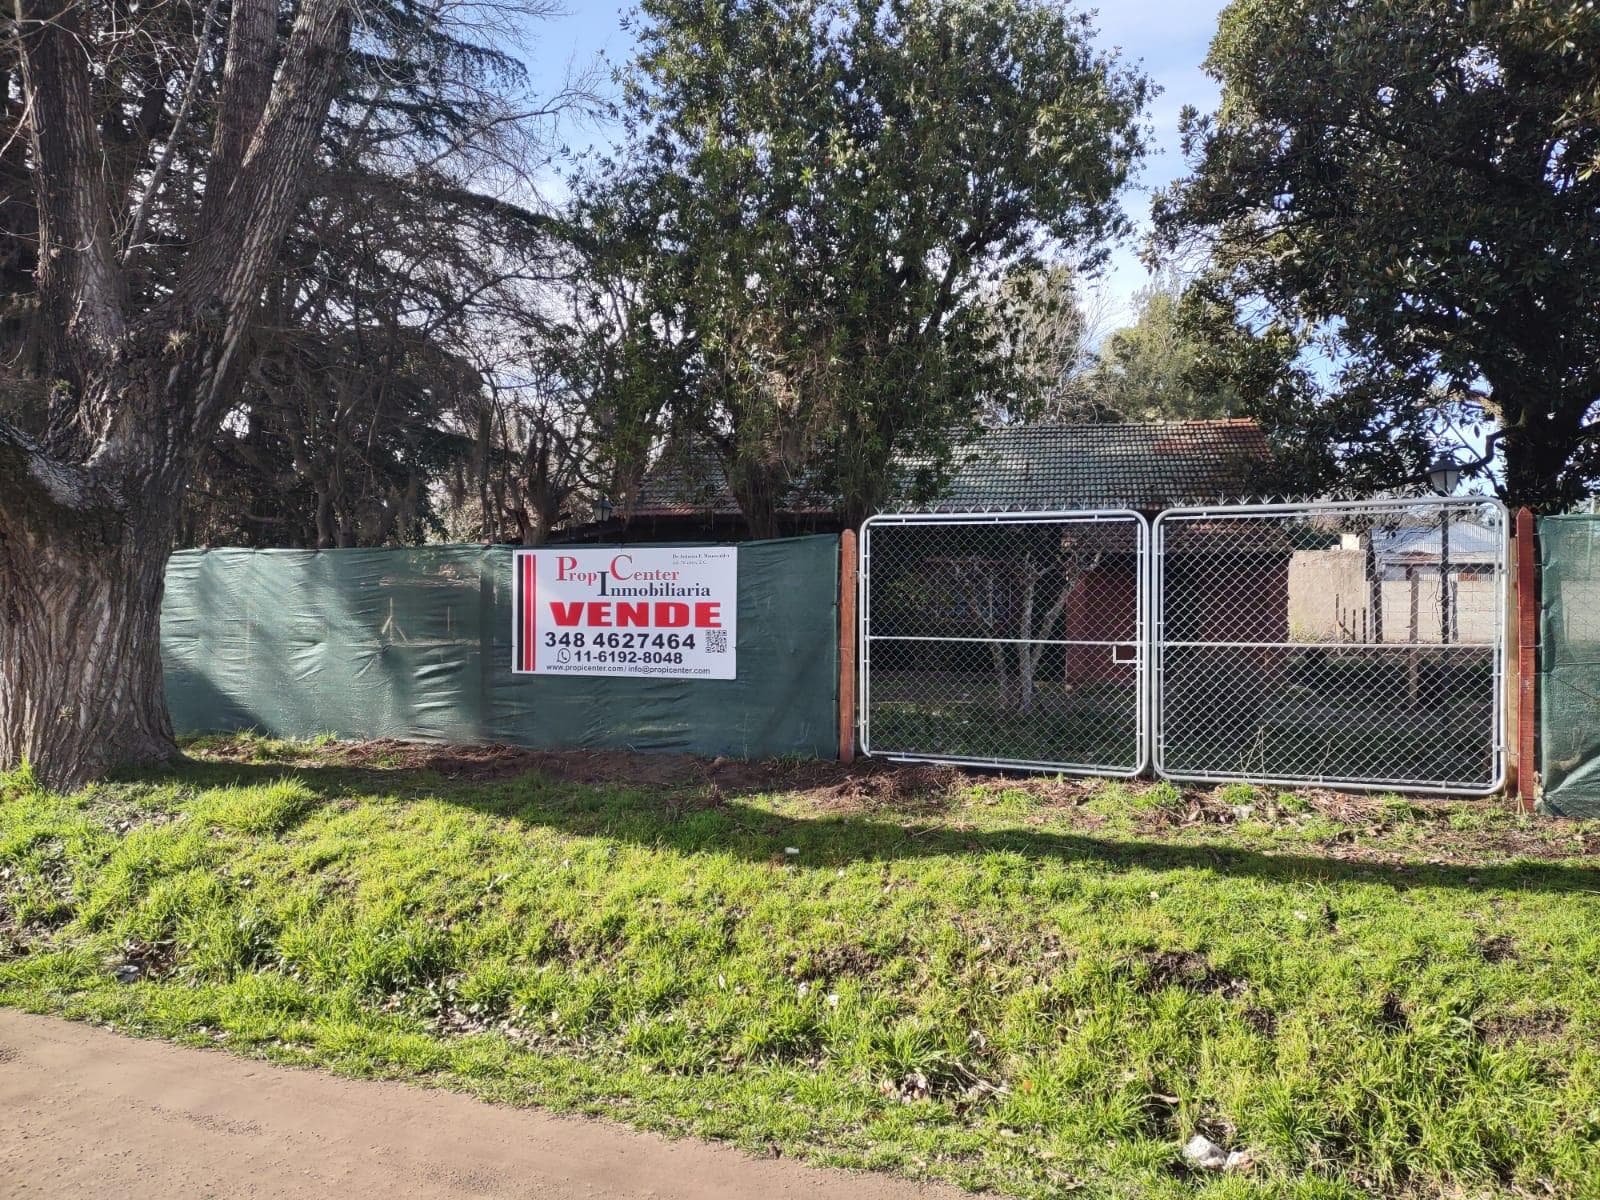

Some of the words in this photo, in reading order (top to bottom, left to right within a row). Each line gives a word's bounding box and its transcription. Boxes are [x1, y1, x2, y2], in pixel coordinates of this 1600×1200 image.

[610, 554, 680, 581] Center
[597, 571, 711, 597] Inmobiliaria
[549, 602, 722, 628] VENDE
[545, 632, 586, 648] 348
[592, 633, 696, 650] 4627464
[575, 650, 683, 664] 11-6192-8048
[627, 665, 711, 675] info@propicenter.com
